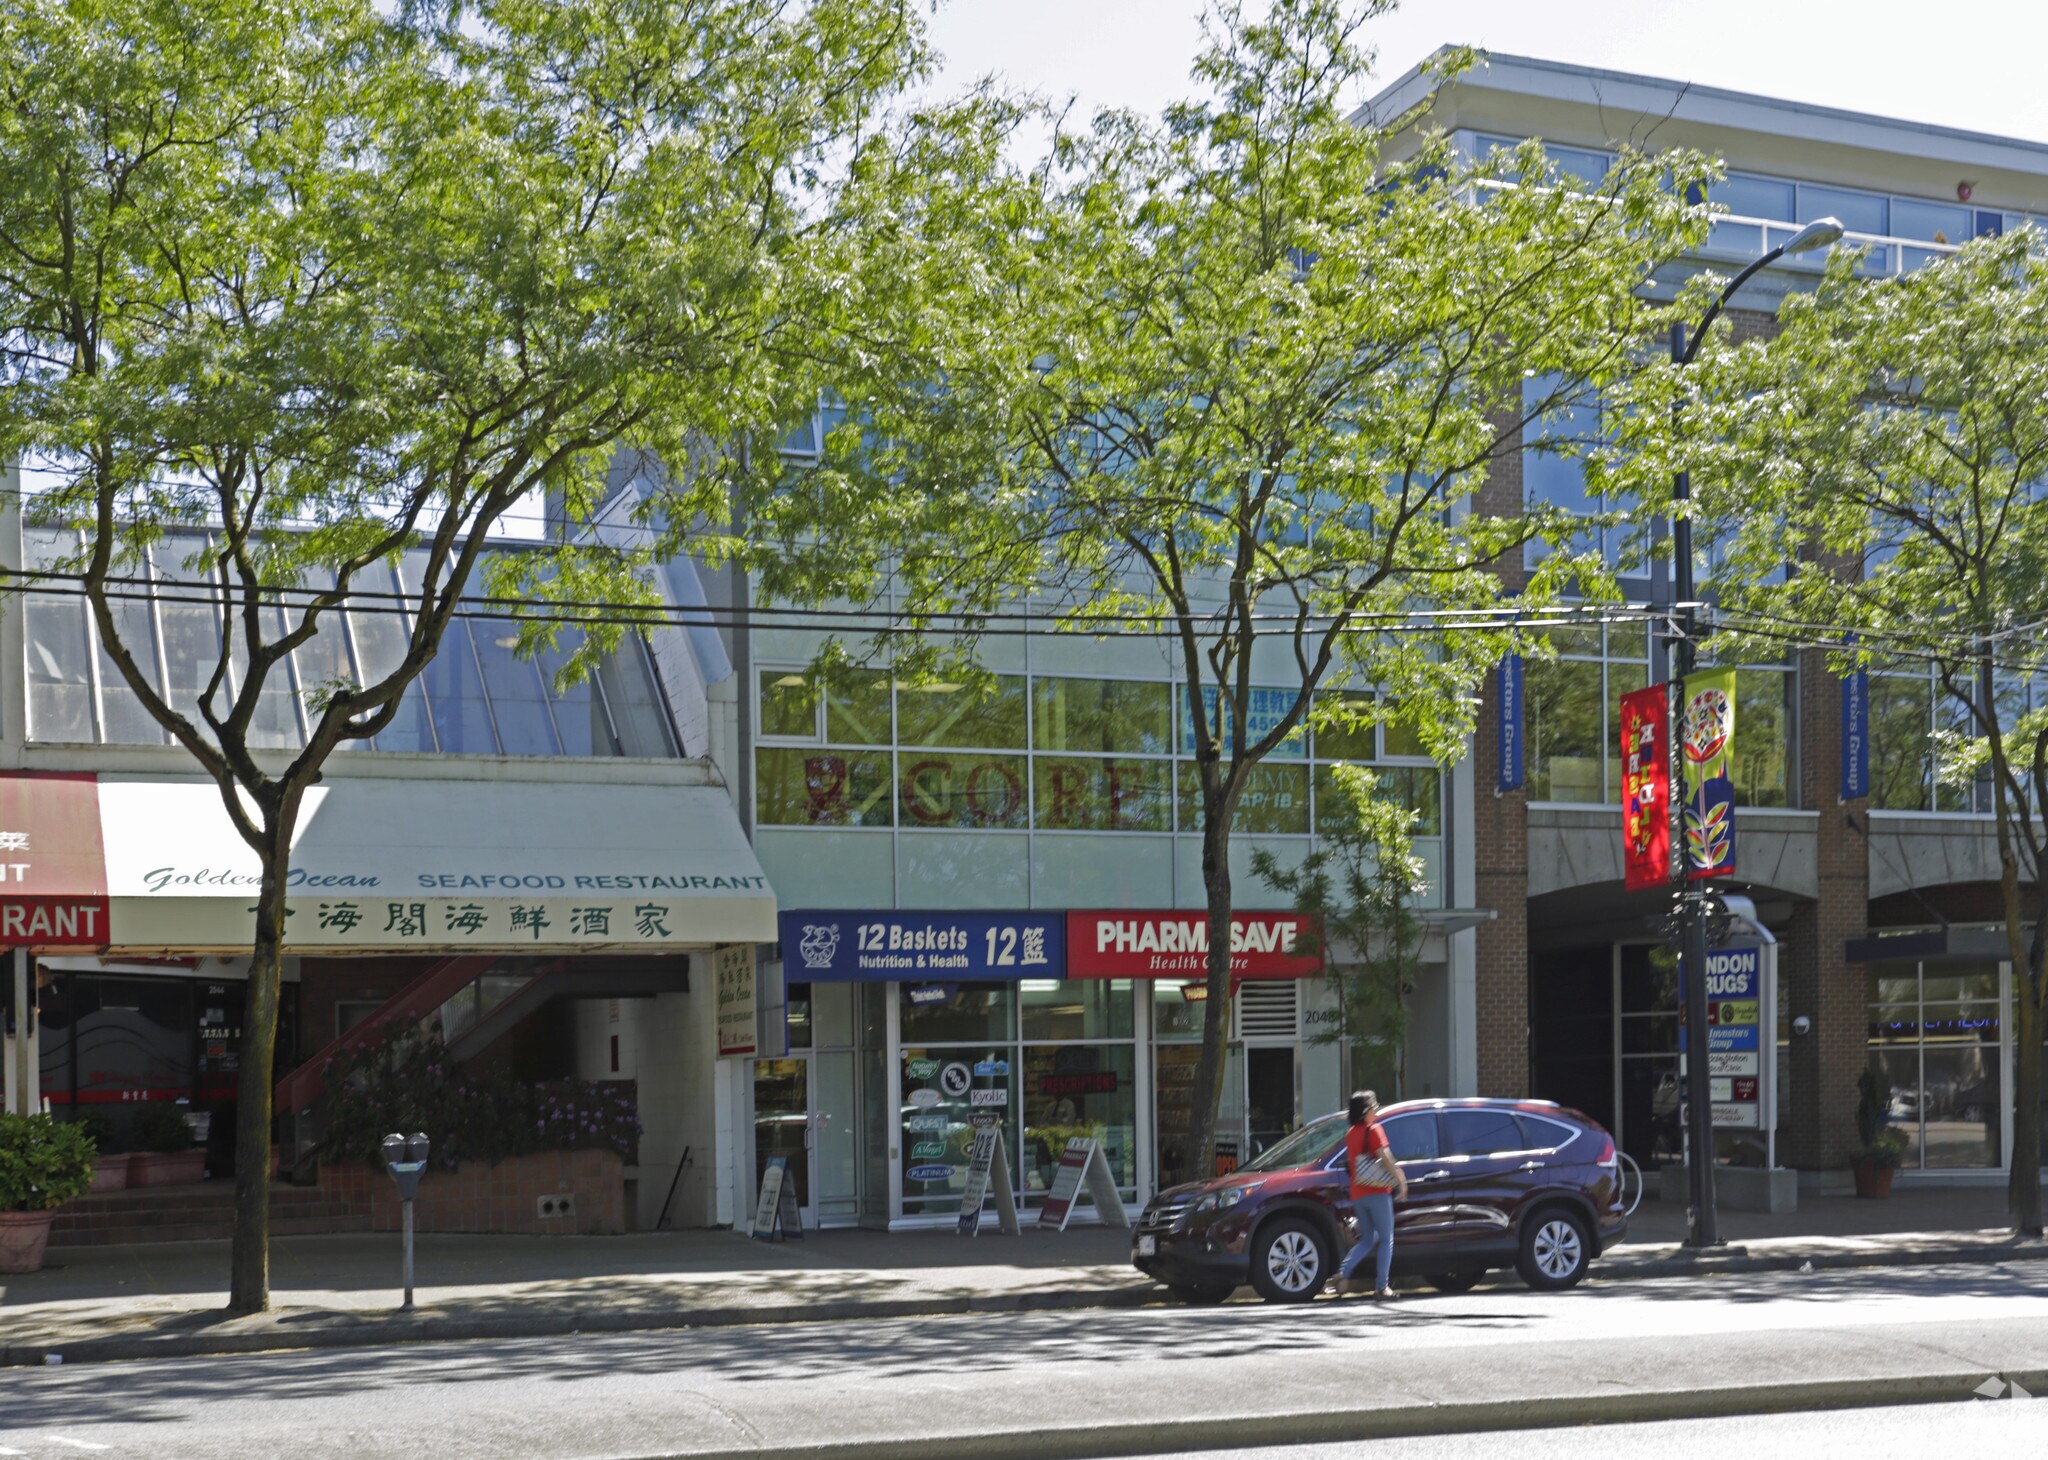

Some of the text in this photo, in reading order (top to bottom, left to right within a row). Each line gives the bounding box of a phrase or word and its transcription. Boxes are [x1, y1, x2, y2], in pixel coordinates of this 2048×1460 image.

[1502, 724, 1516, 782] Group
[1847, 735, 1861, 790] Group
[286, 868, 382, 887] Ocean
[418, 874, 765, 889] SEAFOOD RESTAURANT
[3, 905, 101, 937] RANT
[247, 902, 672, 939] 海閣海鮮酒家
[1096, 920, 1297, 953] PHARMSAVE
[859, 955, 969, 968] Nutrition & Health
[1150, 955, 1249, 970] Health Ctre
[1706, 953, 1756, 975] NDON
[1709, 1028, 1750, 1039] Investors
[973, 1089, 1006, 1104] Kyolic
[912, 1118, 945, 1130] QUEST
[911, 1168, 953, 1178] PLATINUM
